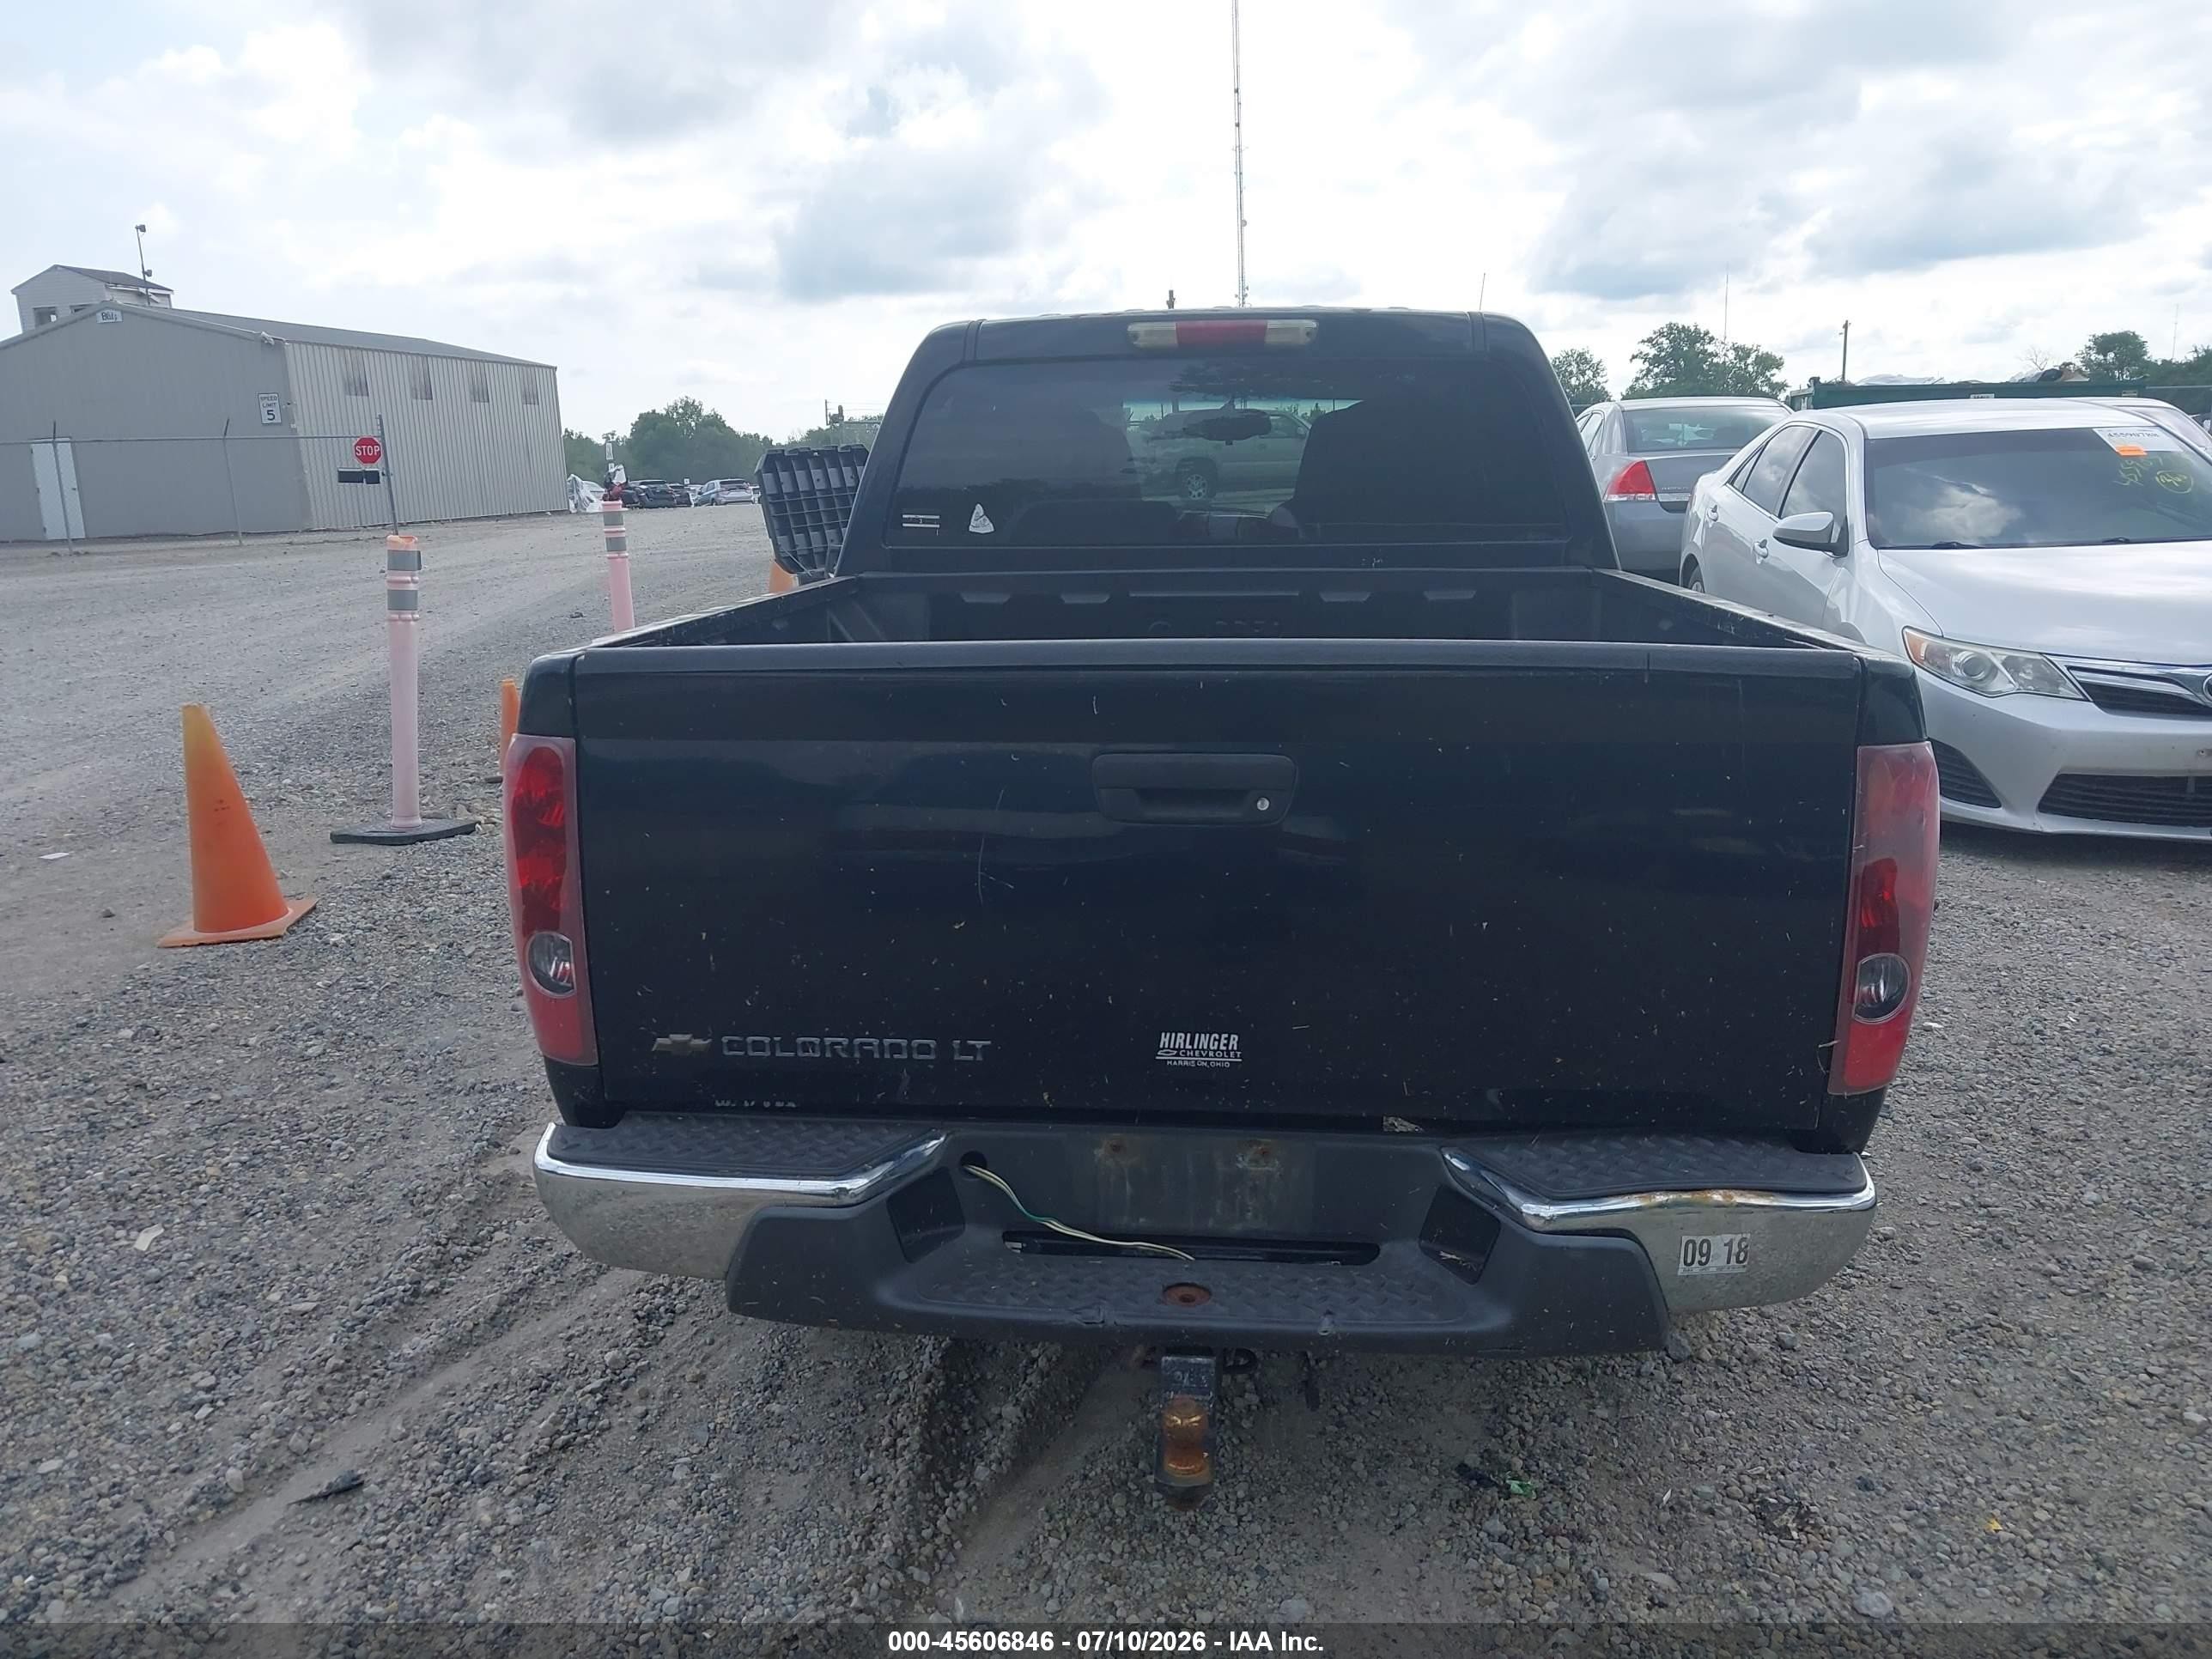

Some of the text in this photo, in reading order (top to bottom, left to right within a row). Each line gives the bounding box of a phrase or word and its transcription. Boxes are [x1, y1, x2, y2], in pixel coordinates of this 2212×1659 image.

[267, 410, 275, 421] 5
[356, 445, 380, 456] STOP
[721, 1036, 992, 1060] COLORADO LT
[1159, 1032, 1239, 1051] HIRLINGER
[1179, 1049, 1242, 1059] CHEVROLET
[1683, 1237, 1748, 1267] 09 18
